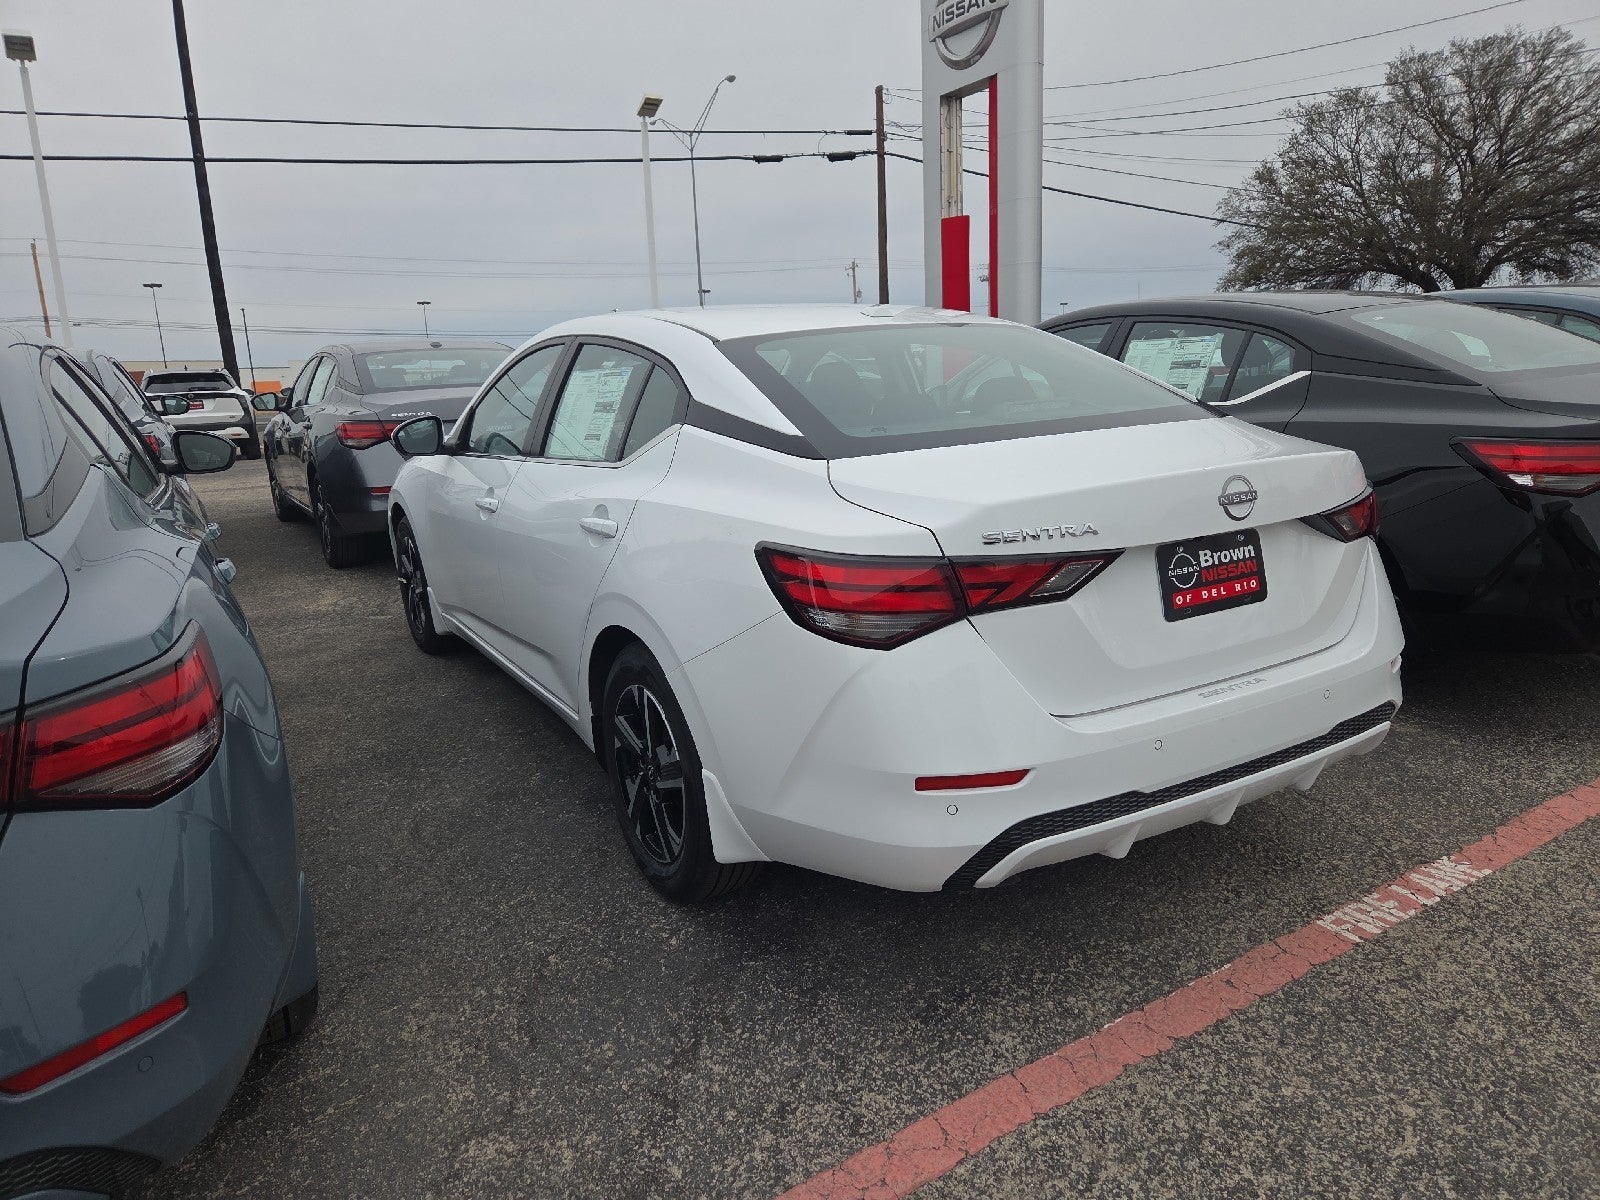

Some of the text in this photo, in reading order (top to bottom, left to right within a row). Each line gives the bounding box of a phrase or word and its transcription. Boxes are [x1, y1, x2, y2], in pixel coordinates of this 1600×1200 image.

[932, 0, 998, 32] NISSA
[1220, 491, 1258, 504] NISSAN
[981, 522, 1099, 545] SENTRA
[1198, 544, 1256, 568] Brown
[1168, 564, 1200, 577] NISSAN
[1201, 559, 1258, 583] NISSAN
[1175, 579, 1257, 605] OF DEL RIO
[1315, 892, 1417, 943] FIRE
